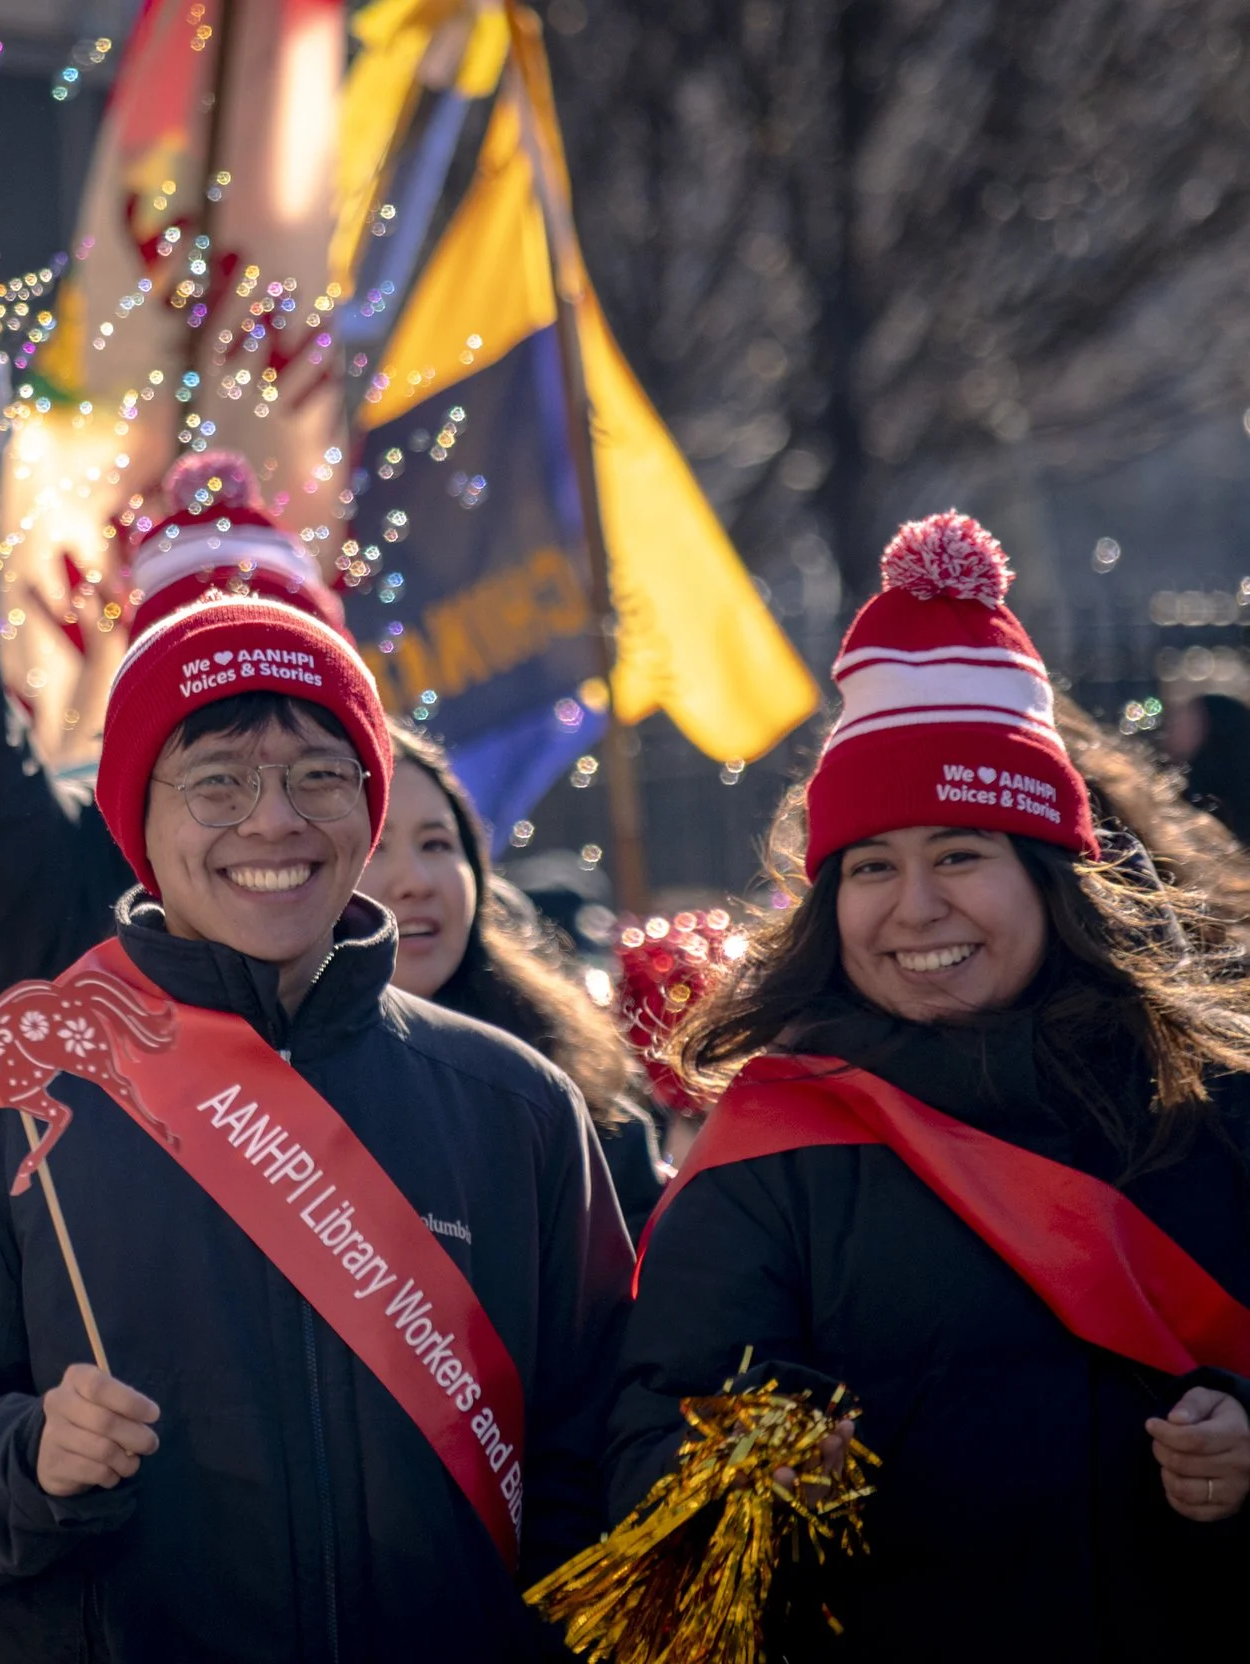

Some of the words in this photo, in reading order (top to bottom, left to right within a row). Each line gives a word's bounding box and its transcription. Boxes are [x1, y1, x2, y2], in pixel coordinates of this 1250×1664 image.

[179, 668, 237, 698] Voices
[240, 662, 255, 677] &
[259, 662, 323, 687] Stories
[182, 658, 211, 679] We
[237, 649, 315, 669] AANHPI
[943, 764, 975, 782] We
[999, 770, 1057, 802] AANHPI
[936, 783, 997, 805] Voices
[1000, 789, 1014, 808] &
[1016, 793, 1062, 824] Stories
[197, 1084, 324, 1204] AANHPI
[300, 1184, 397, 1300] Library
[385, 1278, 481, 1413] Workers
[471, 1407, 514, 1473] and
